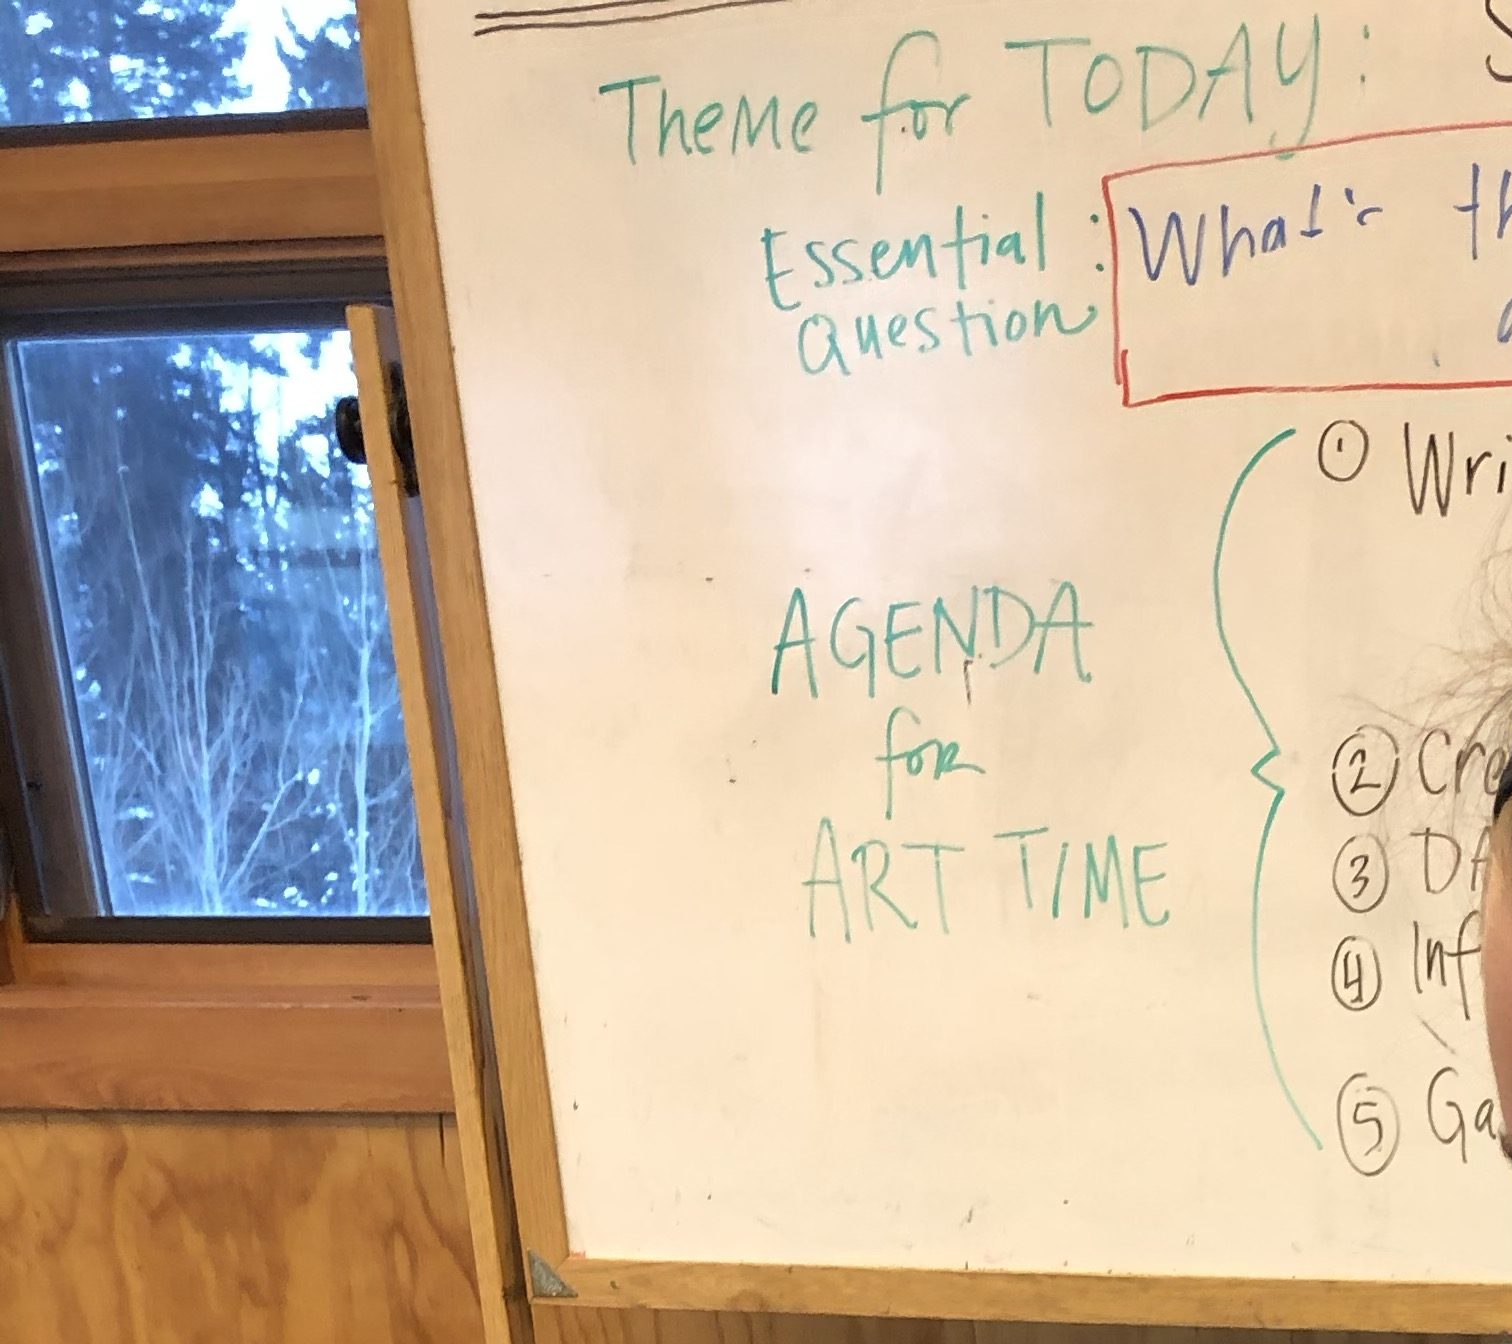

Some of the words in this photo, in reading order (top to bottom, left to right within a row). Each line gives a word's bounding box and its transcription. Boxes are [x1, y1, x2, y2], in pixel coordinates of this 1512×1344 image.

[861, 30, 972, 195] for
[769, 580, 1093, 700] AGENDA
[802, 816, 967, 944] ART
[992, 825, 1172, 931] TIME
